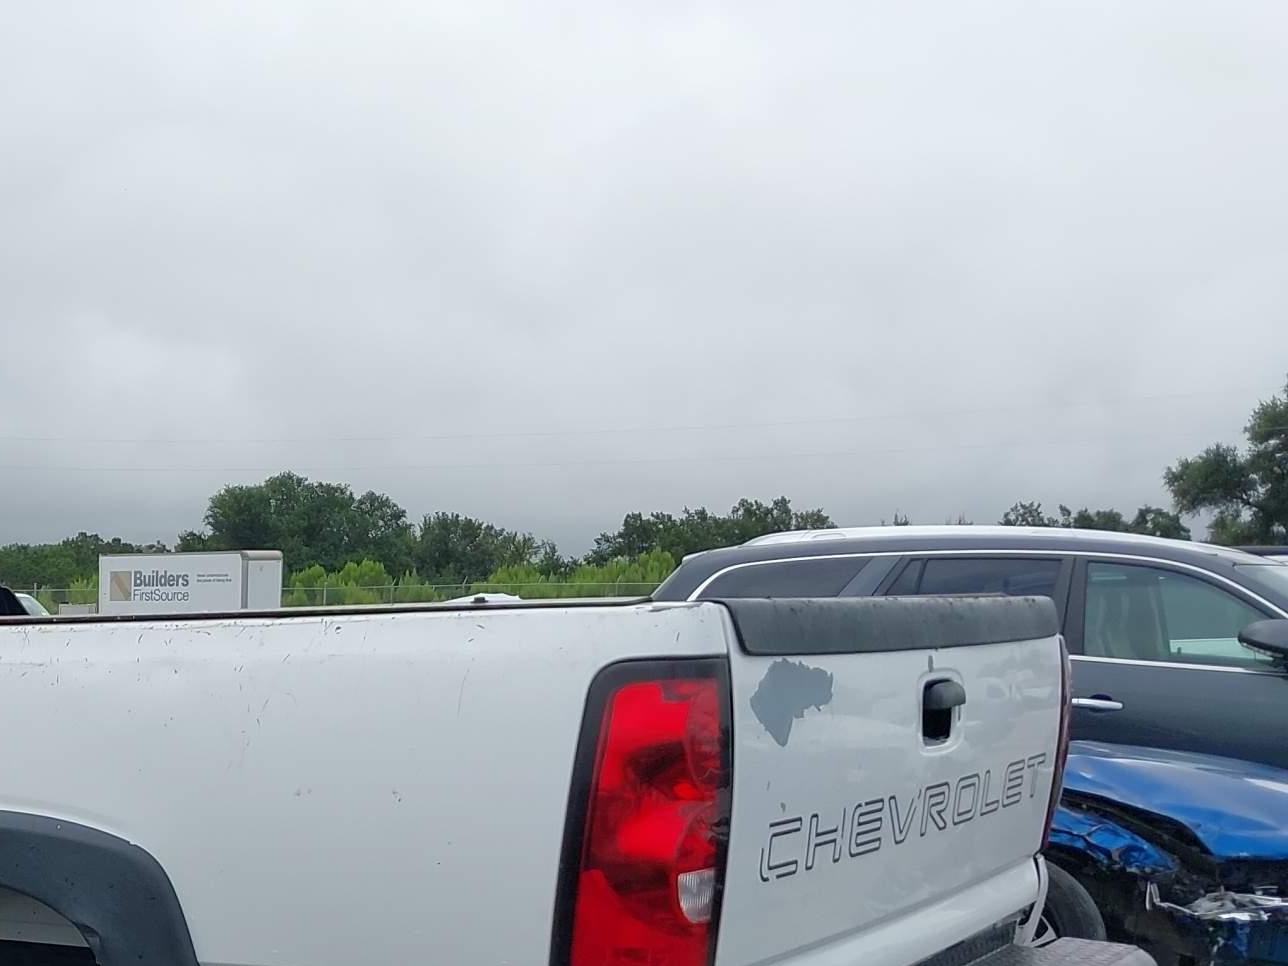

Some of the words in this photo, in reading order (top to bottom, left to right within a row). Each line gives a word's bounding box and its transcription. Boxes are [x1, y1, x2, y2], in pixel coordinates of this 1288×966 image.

[133, 570, 189, 587] Builders
[133, 589, 189, 602] FirstSource
[760, 752, 1047, 882] CHEVROLET
